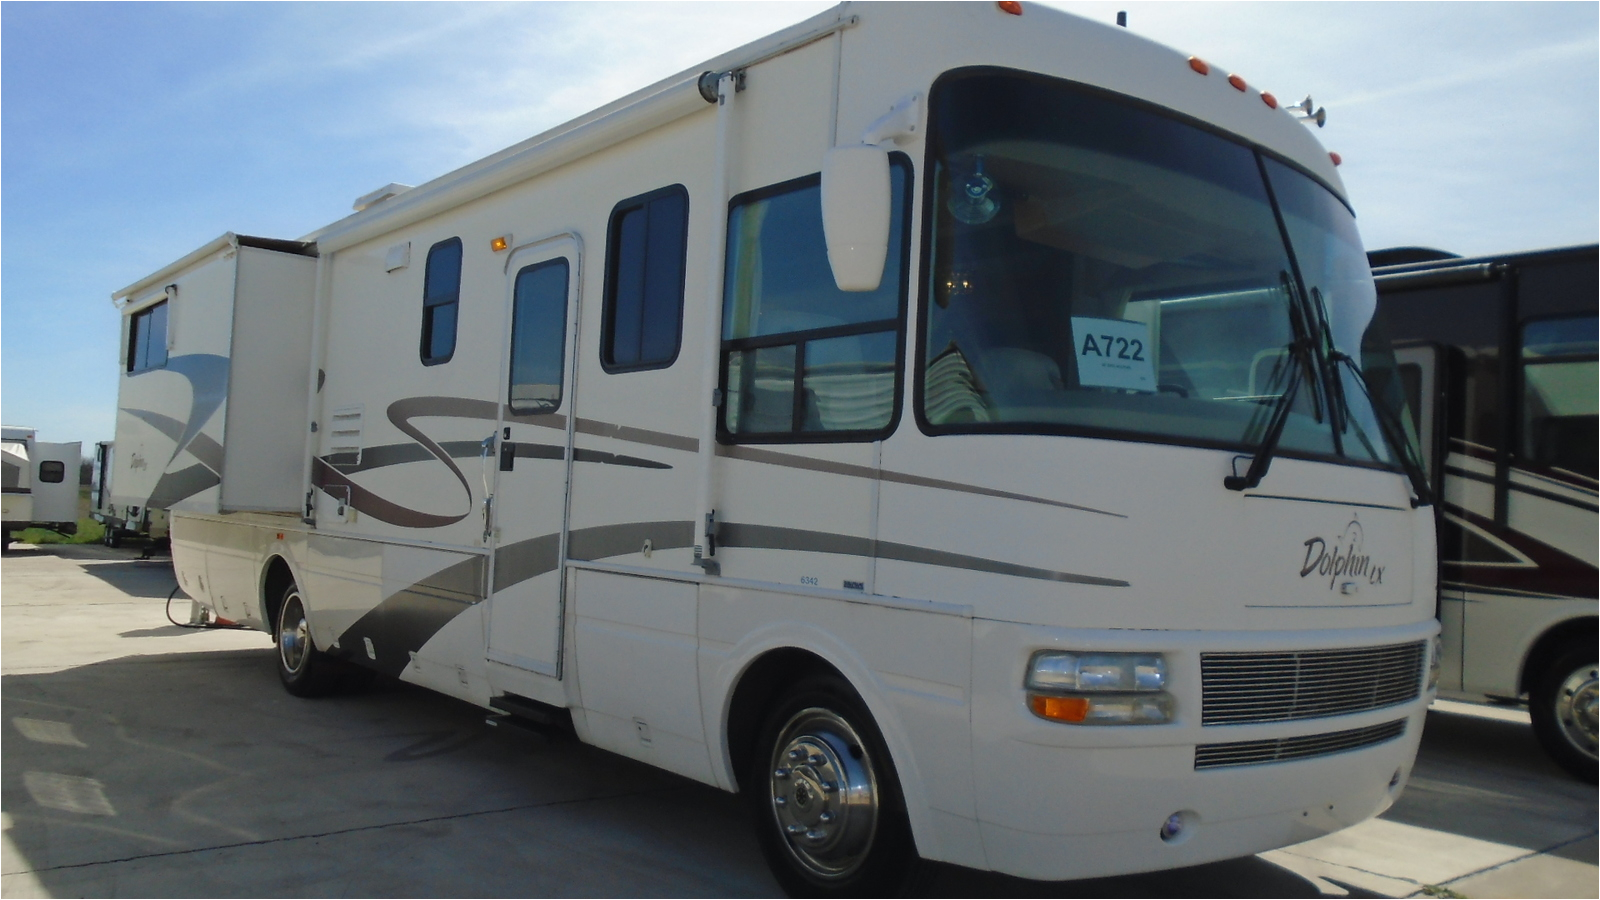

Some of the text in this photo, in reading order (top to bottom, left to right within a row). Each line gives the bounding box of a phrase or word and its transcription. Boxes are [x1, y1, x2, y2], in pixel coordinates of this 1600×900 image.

[1081, 333, 1145, 362] A722
[1300, 536, 1370, 590] Dolphin
[800, 576, 819, 586] 6342
